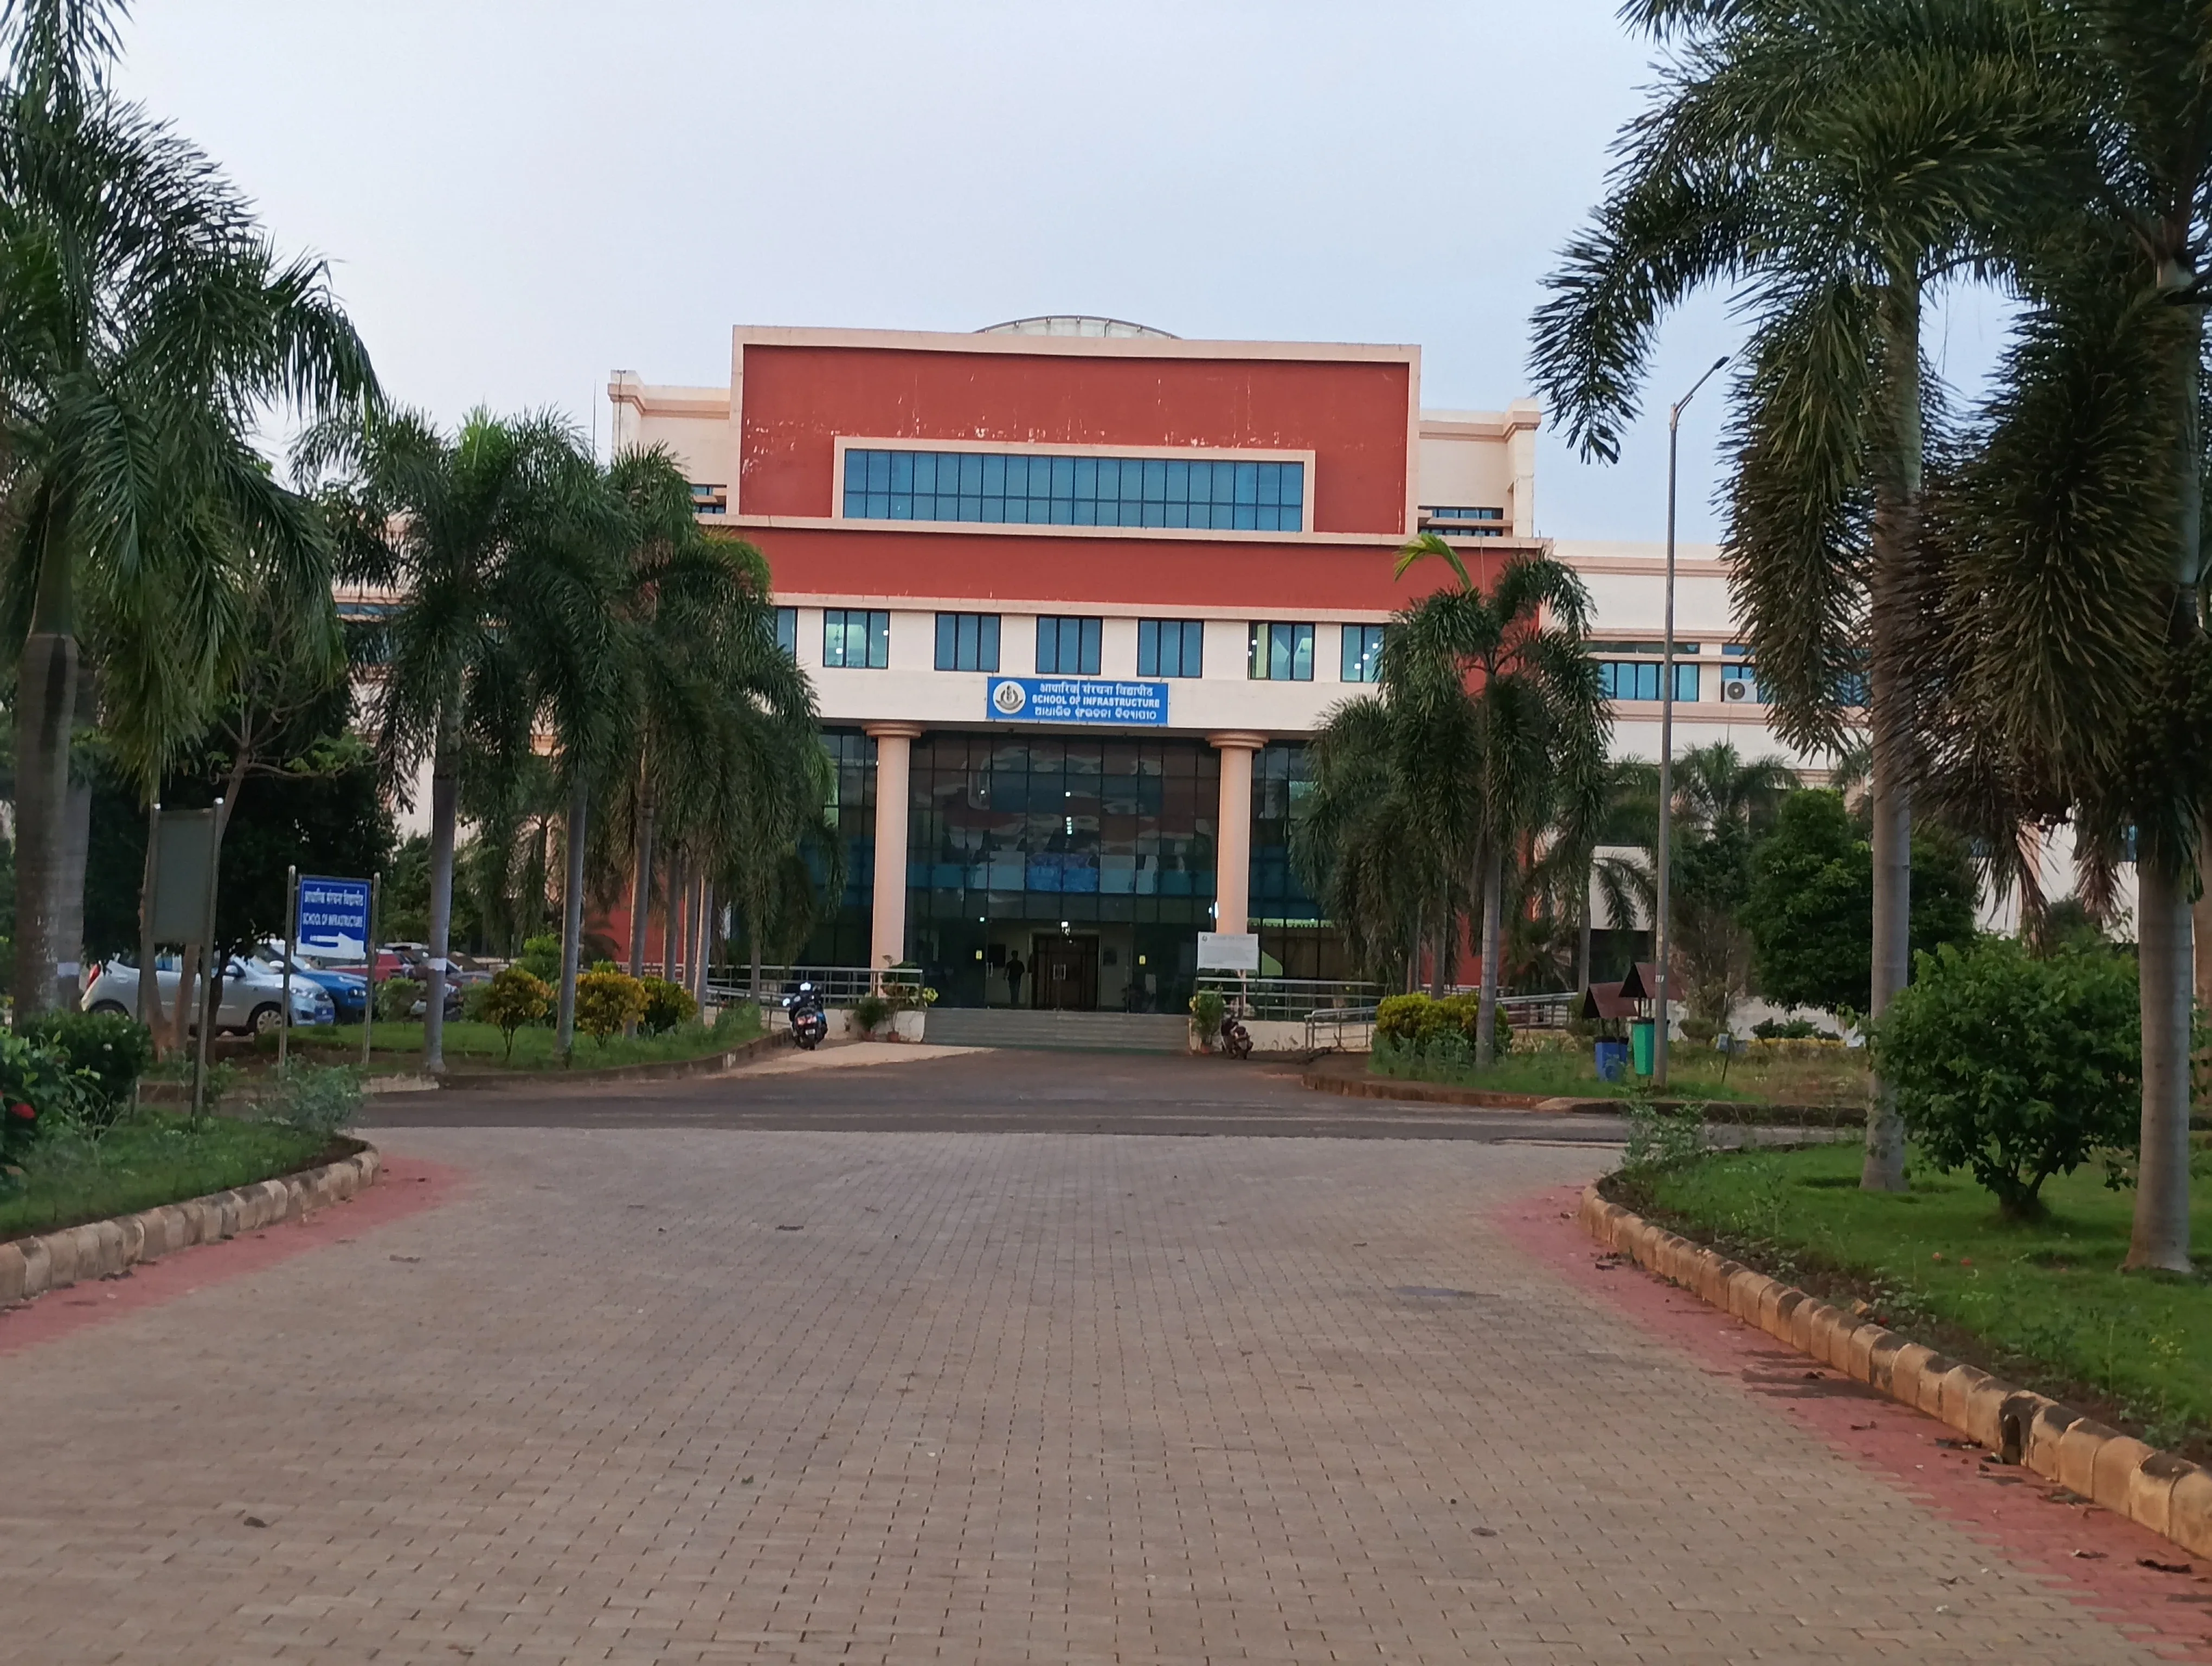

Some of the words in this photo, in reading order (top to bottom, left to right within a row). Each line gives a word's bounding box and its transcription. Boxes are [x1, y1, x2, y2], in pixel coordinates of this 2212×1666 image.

[1032, 694, 1067, 704] SCHOOL
[1069, 696, 1081, 705] OF
[1083, 696, 1160, 708] INFRASTRUCTURE
